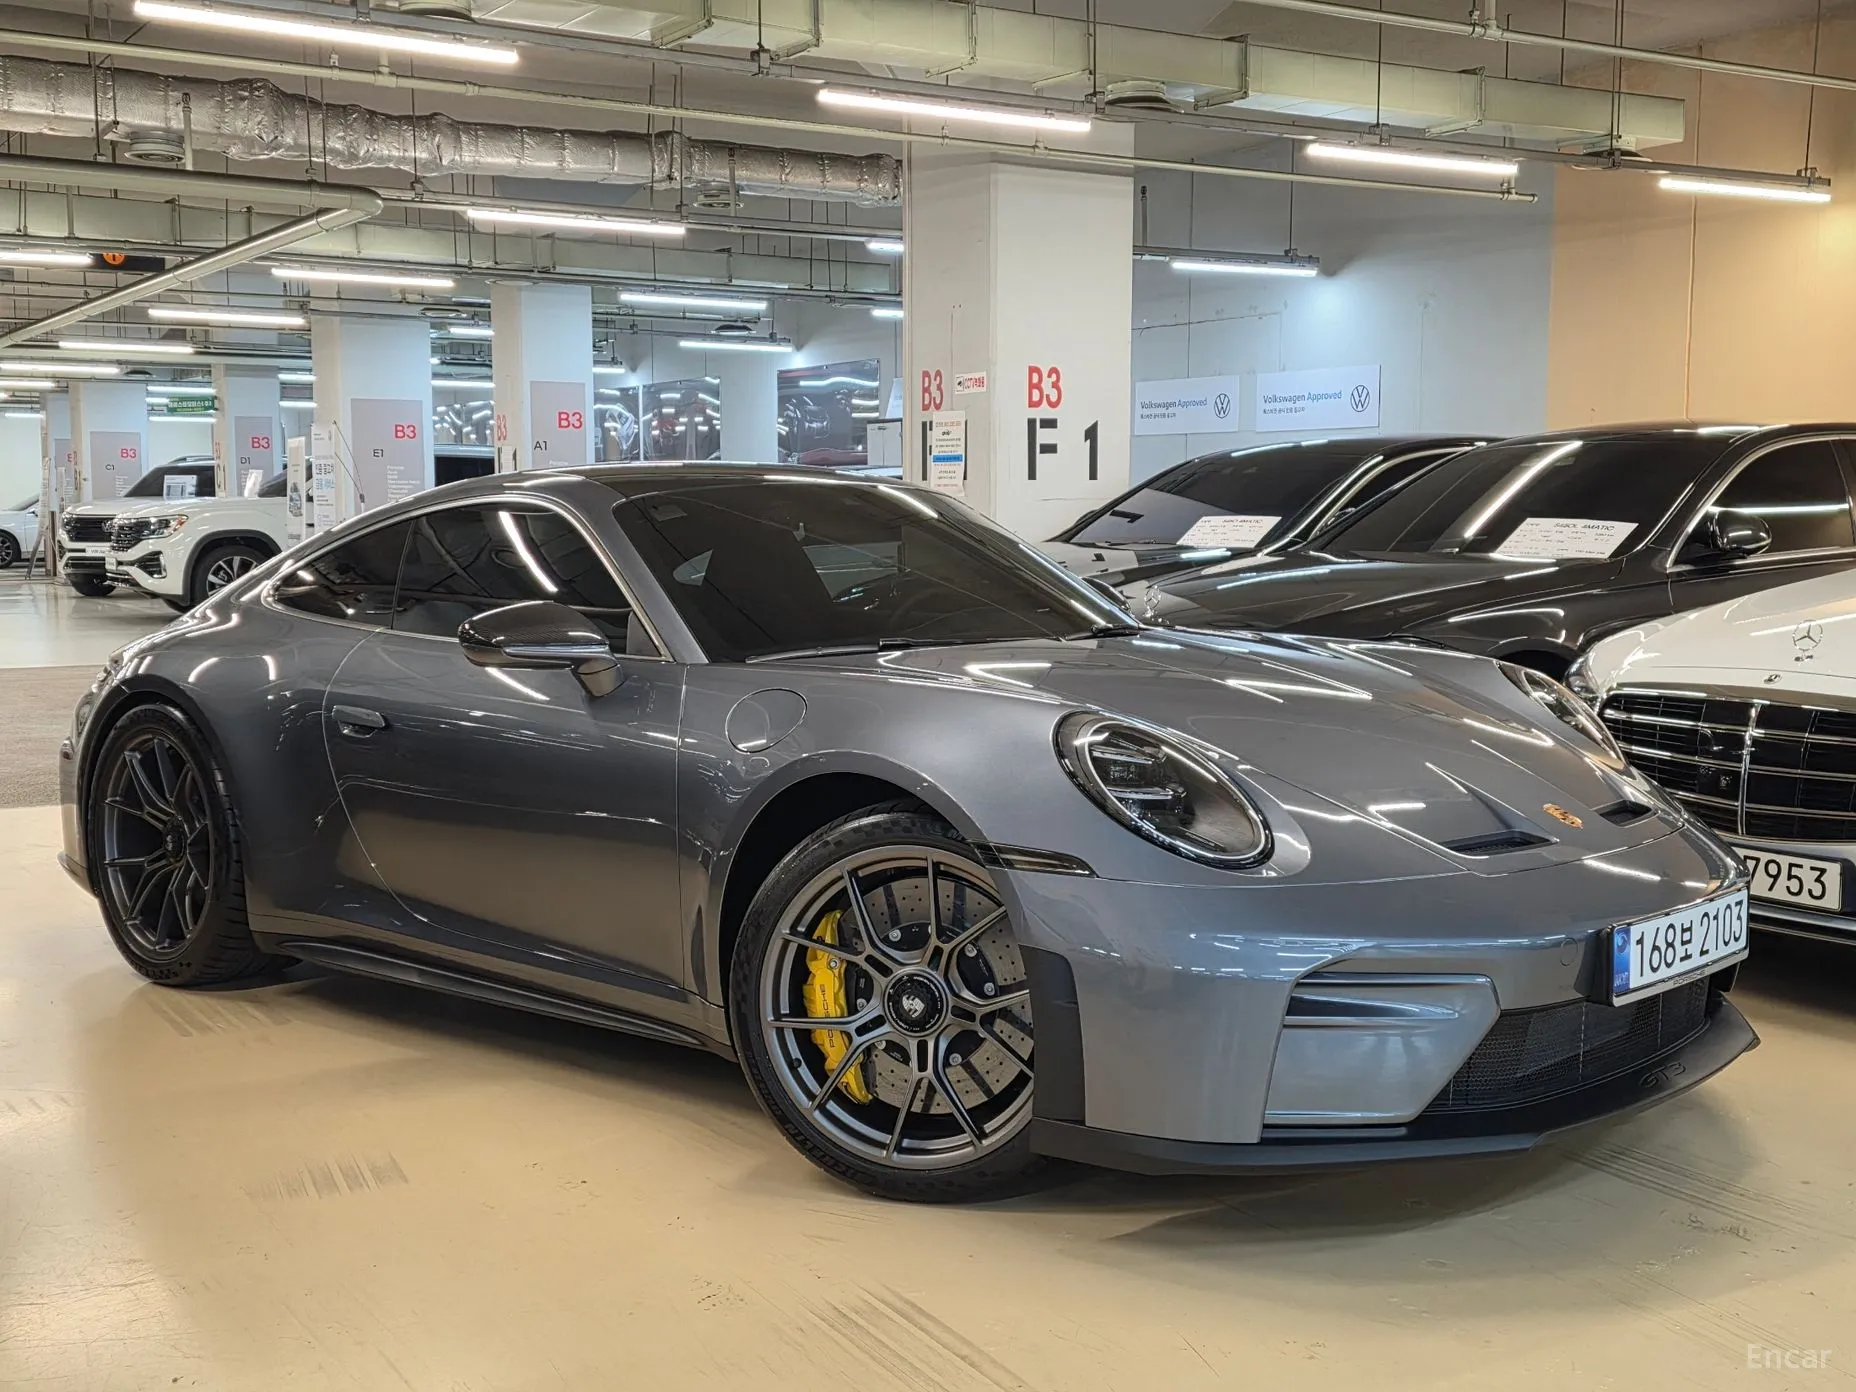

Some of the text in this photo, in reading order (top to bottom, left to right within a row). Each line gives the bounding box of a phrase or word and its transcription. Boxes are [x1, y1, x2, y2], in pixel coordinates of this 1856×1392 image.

[921, 369, 944, 411] B3
[1027, 365, 1063, 409] B3
[1140, 398, 1208, 410] Volkswagen Approved
[1262, 390, 1343, 404] Volkswagen Approved
[557, 411, 583, 430] B3
[394, 424, 417, 439] B3
[251, 436, 271, 449] B3
[534, 441, 548, 451] A1
[120, 448, 137, 459] B3
[372, 449, 384, 458] E1
[240, 457, 251, 465] D1
[1743, 855, 1828, 901] 7953
[1636, 900, 1744, 978] 168보 2103
[819, 983, 836, 1048] POSCHE
